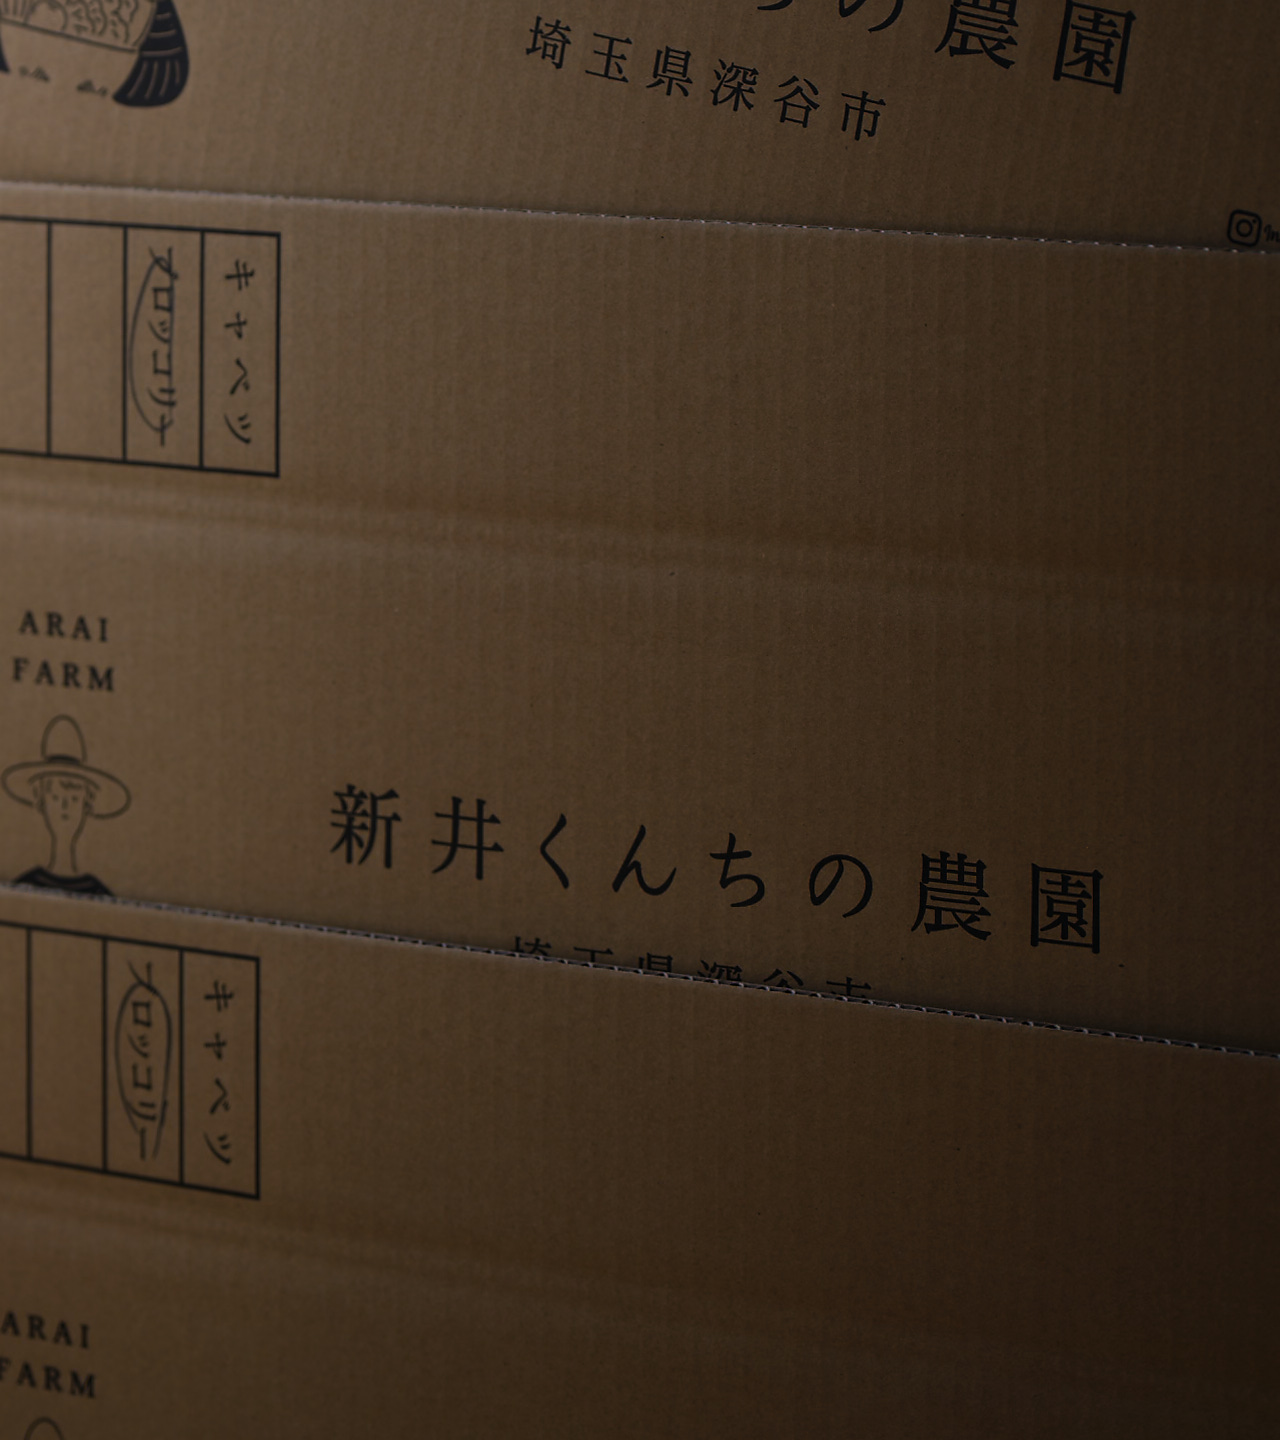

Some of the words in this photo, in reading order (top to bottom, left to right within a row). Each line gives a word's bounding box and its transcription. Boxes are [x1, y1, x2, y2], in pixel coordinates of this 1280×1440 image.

[525, 15, 887, 142] 埼玉県深谷市
[225, 259, 254, 444] キャベツ
[12, 657, 115, 692] FARM
[18, 610, 109, 642] ARAI
[330, 783, 1104, 955] 新井くんちの農園
[204, 980, 234, 1164] キャベツ
[0, 1310, 90, 1349] ARAI
